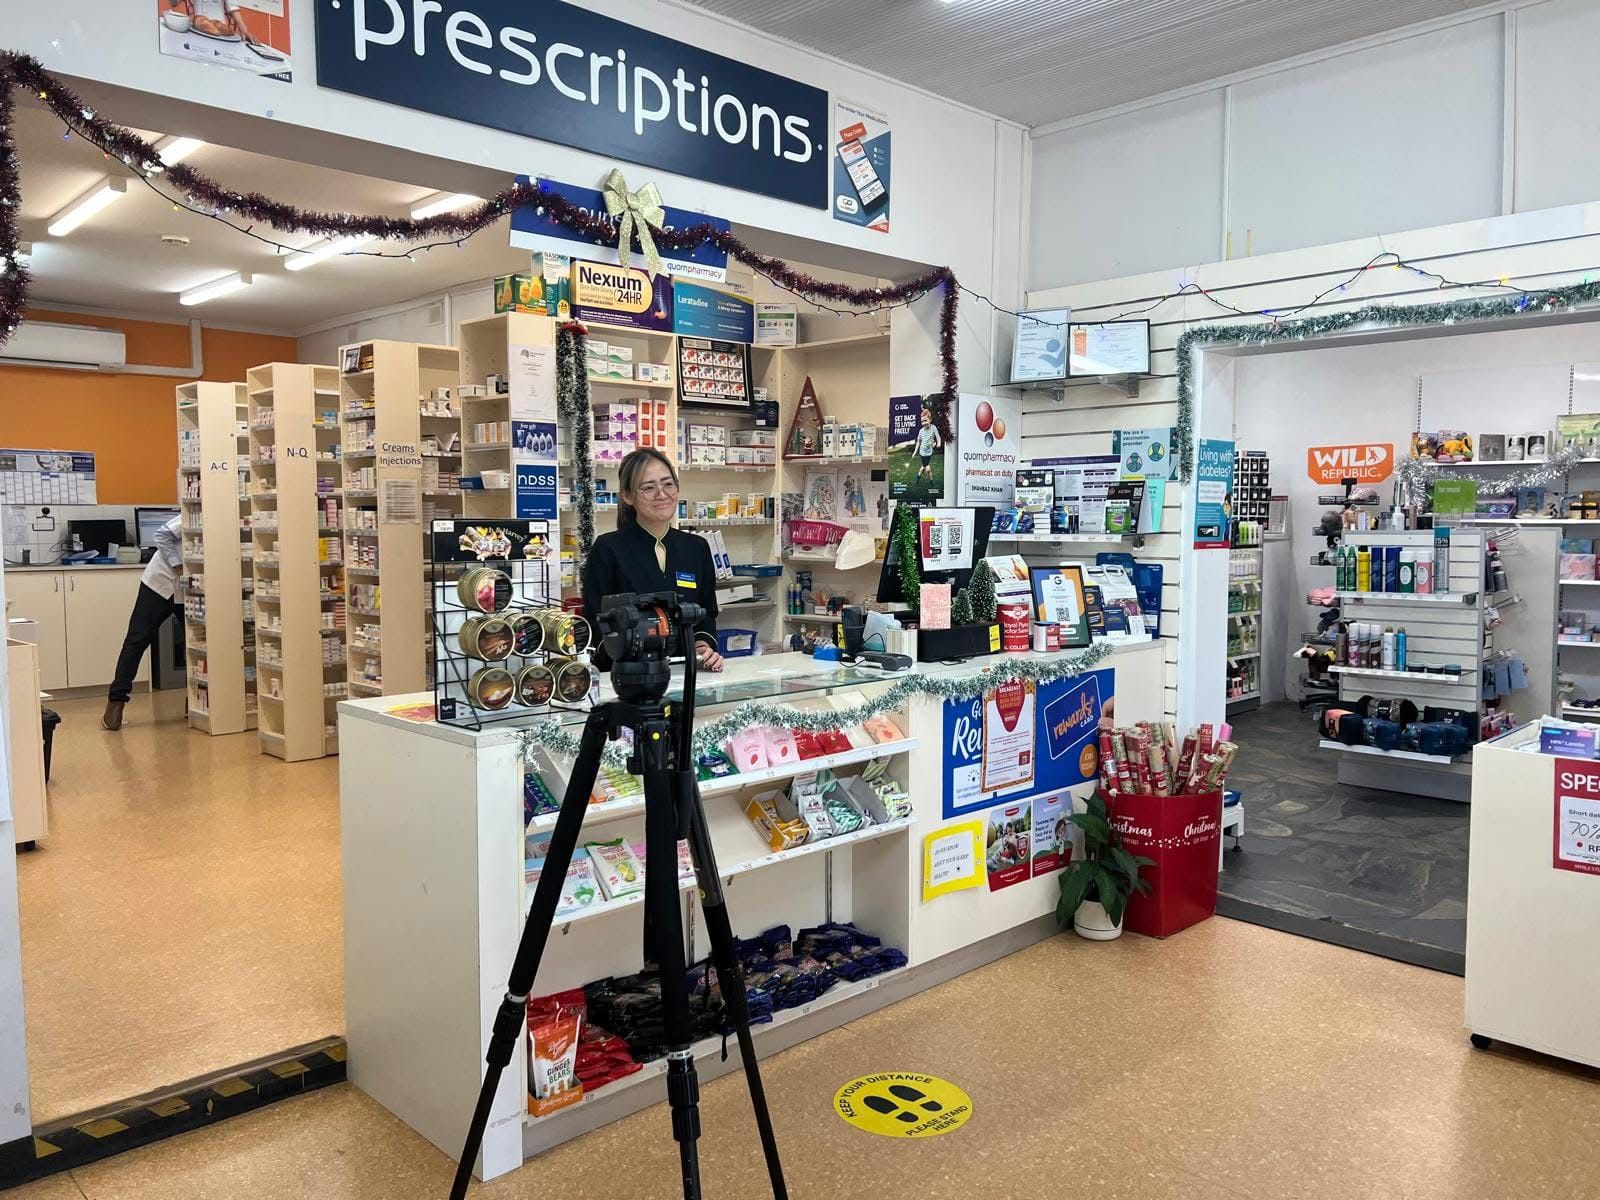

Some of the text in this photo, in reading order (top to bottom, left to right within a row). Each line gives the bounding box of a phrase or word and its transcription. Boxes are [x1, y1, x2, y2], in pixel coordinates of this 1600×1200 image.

[354, 0, 813, 164] prescriptions
[666, 262, 723, 280] quornpharmacy
[580, 266, 642, 293] Nexium
[617, 291, 642, 306] 24HR
[287, 447, 309, 460] N-Q
[382, 443, 415, 455] Creams
[1200, 448, 1234, 464] Living with
[380, 457, 421, 467] Injections
[964, 452, 1015, 464] quornpharmacy
[1313, 446, 1387, 468] WILD
[210, 462, 228, 471] A-C
[966, 468, 993, 477] pharmacist
[1002, 470, 1013, 478] duty
[1200, 464, 1232, 478] diabetes?
[1322, 467, 1378, 480] REPUBLIC
[1053, 692, 1092, 741] rewards
[1080, 716, 1094, 728] CARD
[1560, 772, 1600, 793] SPE
[1569, 809, 1587, 817] Short
[1569, 820, 1600, 839] 70%
[547, 1058, 570, 1076] GINGER
[548, 1068, 570, 1084] BEARS
[839, 1074, 934, 1118] KEEP YOUR DISTANCE
[905, 1105, 969, 1136] PLEASE STAND
[933, 1118, 959, 1132] HERE
